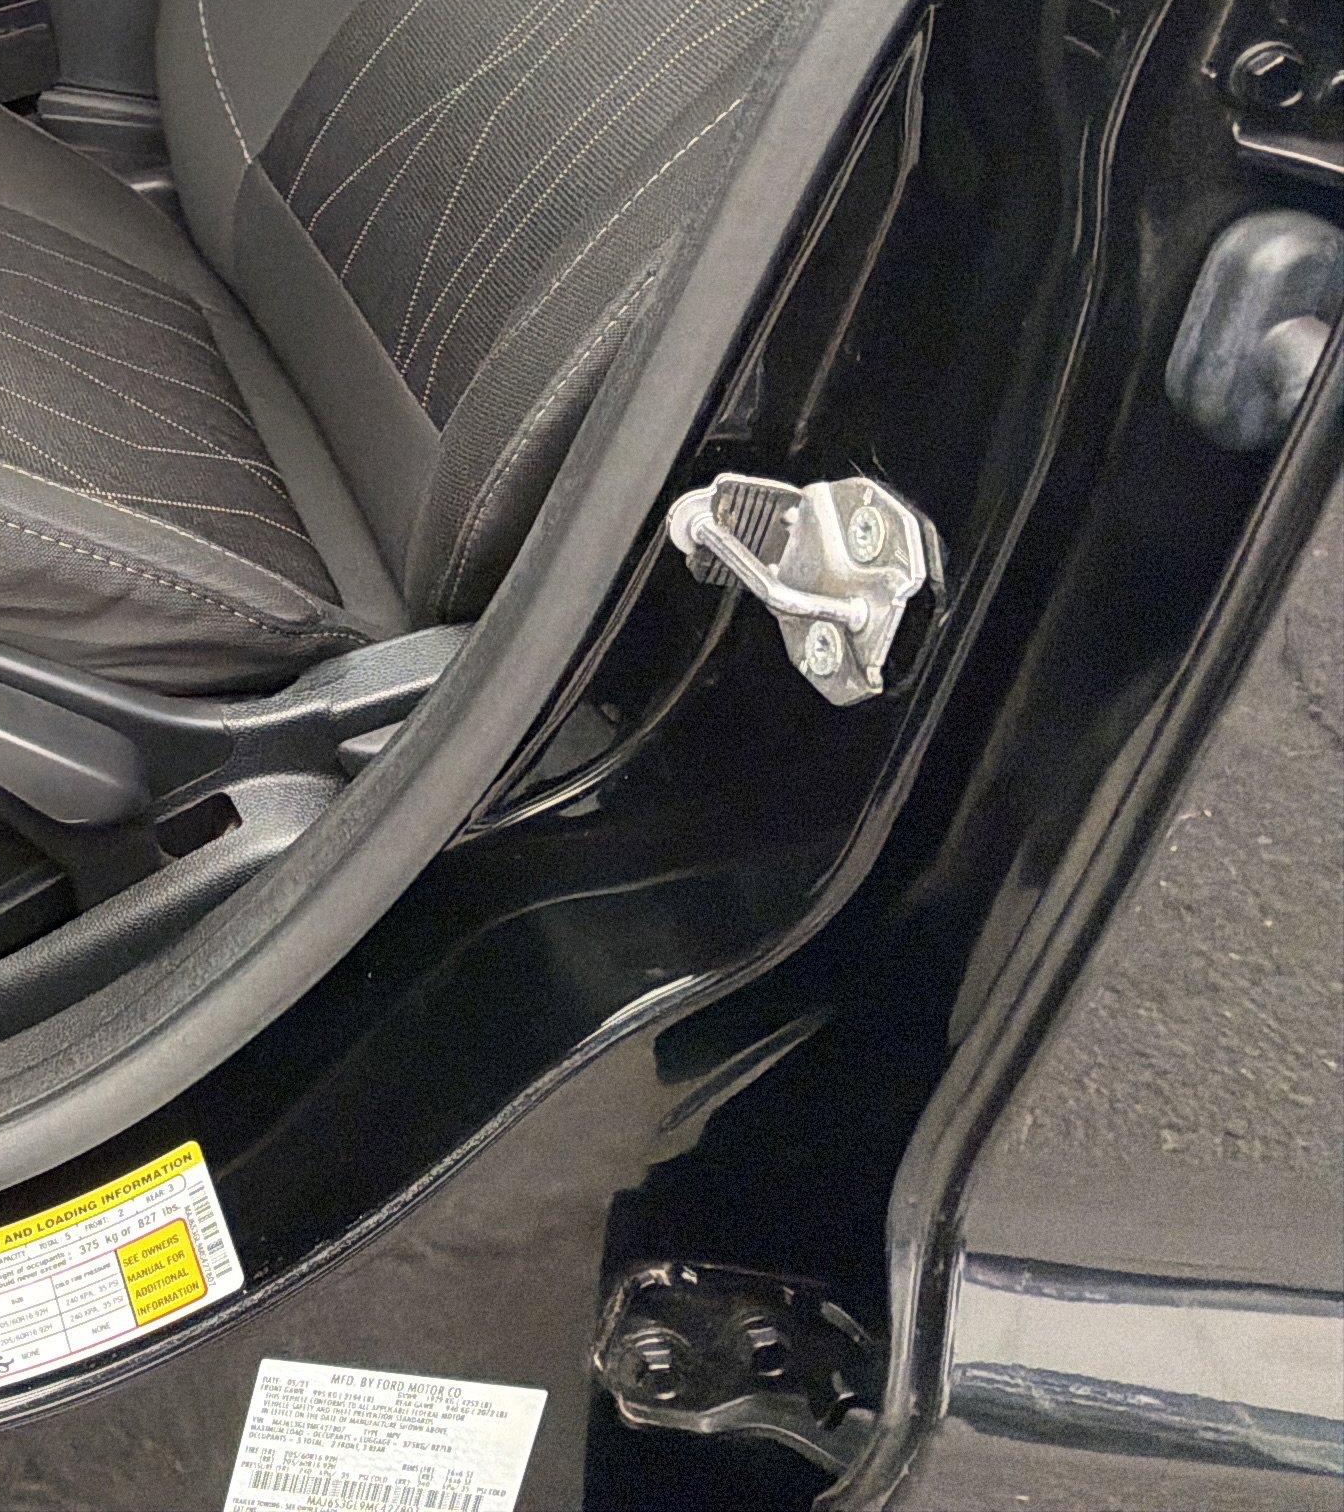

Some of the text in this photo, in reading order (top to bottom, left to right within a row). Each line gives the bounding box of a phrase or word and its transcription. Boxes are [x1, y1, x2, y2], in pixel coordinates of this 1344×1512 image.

[4, 1228, 33, 1244] AND
[36, 1200, 98, 1232] LOADING
[101, 1152, 193, 1205] INFORMATION
[118, 1209, 124, 1217] 2
[169, 1184, 174, 1192] 3
[79, 1239, 99, 1255] 375
[105, 1231, 118, 1244] kg
[121, 1226, 131, 1236] or
[138, 1213, 156, 1229] 827
[123, 1234, 179, 1267] SEE OWNERS
[17, 1269, 37, 1281] never
[40, 1260, 66, 1274] exceed
[26, 1252, 65, 1270] occupants
[127, 1250, 186, 1283] MANUAL FOR
[136, 1268, 189, 1299] ADDITIONAL
[137, 1282, 200, 1316] INFORMATION
[66, 1296, 78, 1306] 240
[70, 1312, 83, 1322] 240
[21, 1322, 110, 1359] NONE NONE
[330, 1374, 356, 1386] MFD.
[360, 1377, 374, 1387] BY
[377, 1379, 404, 1391] FORD
[408, 1382, 445, 1396] MOTOR
